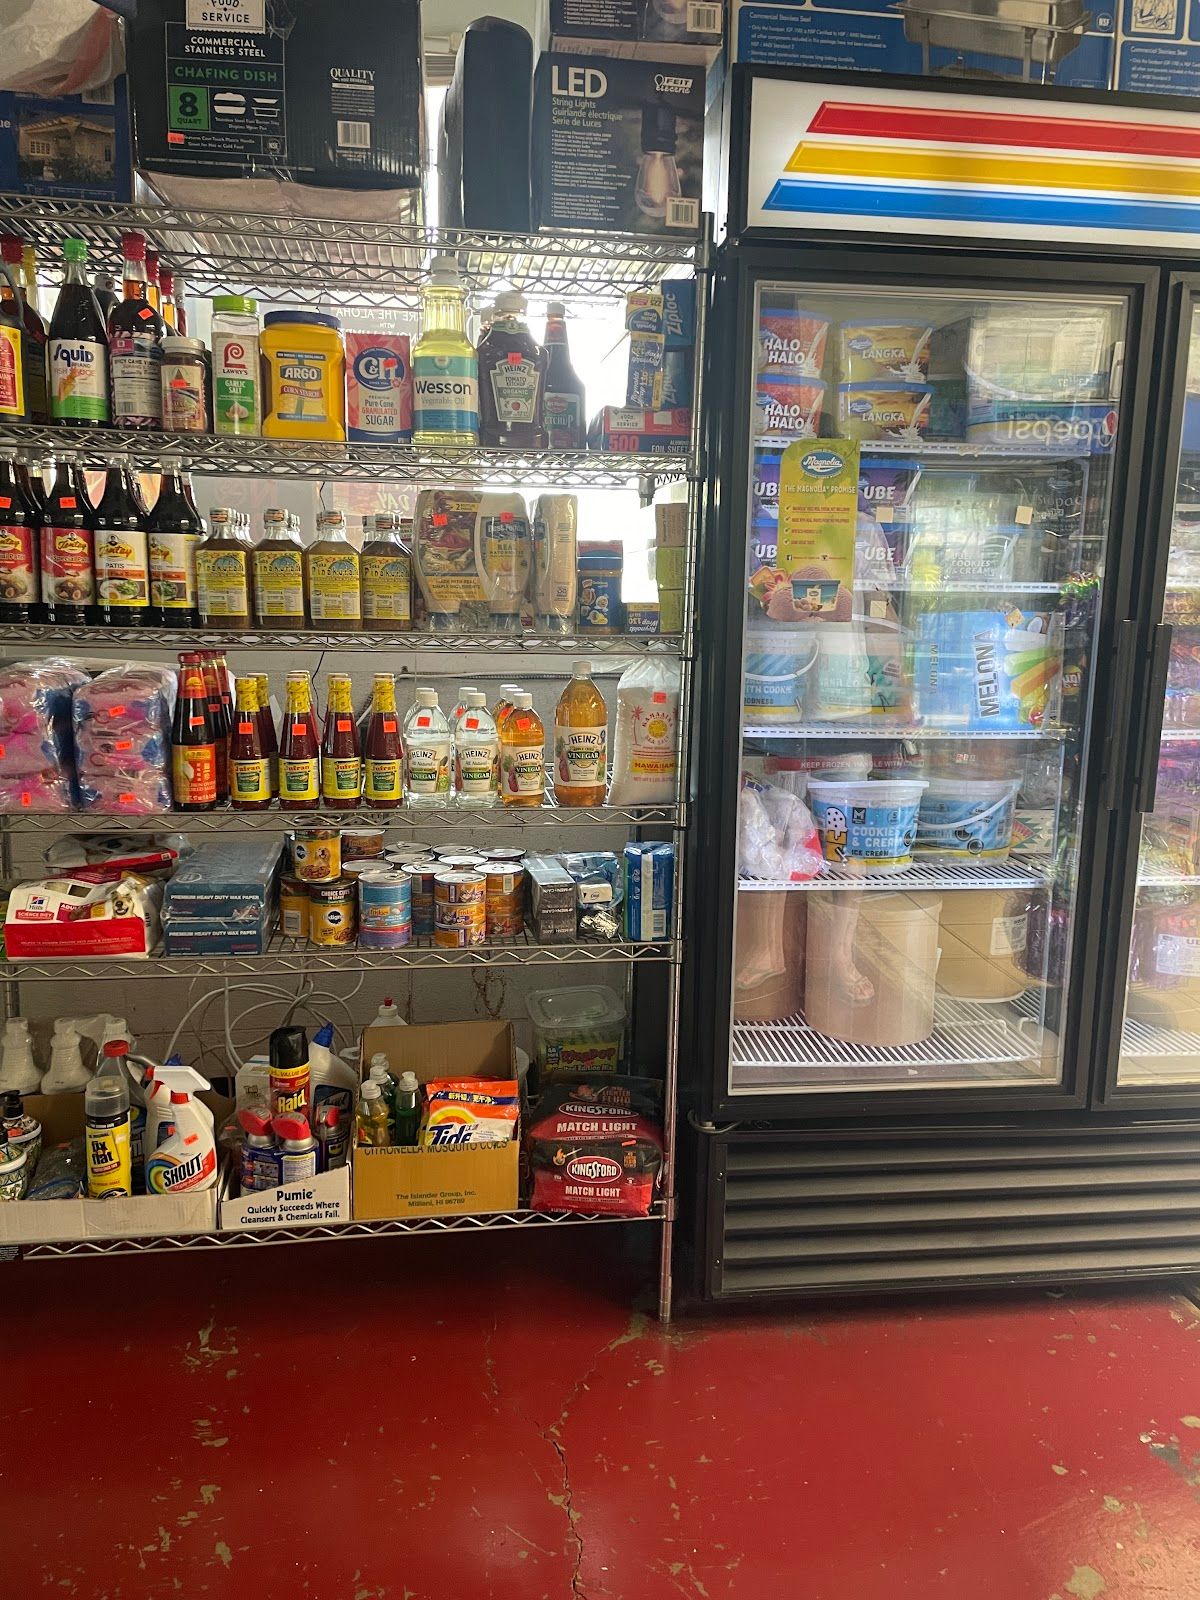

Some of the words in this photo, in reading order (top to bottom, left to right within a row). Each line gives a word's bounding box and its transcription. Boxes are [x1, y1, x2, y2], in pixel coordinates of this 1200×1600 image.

[202, 12, 250, 23] SERVICE
[190, 36, 257, 48] COMMERCIAL
[184, 45, 235, 55] STAINLESS
[238, 48, 266, 57] STEEL
[174, 66, 240, 80] CHAFING
[244, 70, 277, 82] DISH
[330, 67, 375, 81] QUALITY
[551, 65, 608, 98] LED
[666, 78, 690, 86] FEIT
[179, 92, 199, 117] 8
[552, 98, 573, 108] String
[575, 99, 596, 109] Lights
[552, 107, 586, 118] Guirlande
[177, 117, 201, 125] QUART
[552, 116, 570, 126] Serie
[571, 118, 580, 127] de
[582, 119, 602, 128] Luces
[668, 293, 682, 335] Ziploc
[764, 338, 800, 351] HALO
[768, 351, 805, 364] HALO
[862, 349, 906, 359] LANGKA
[284, 367, 318, 380] ARGO
[504, 364, 527, 374] HEINZ
[224, 380, 246, 388] GARLIC
[415, 381, 472, 395] Wesson
[364, 399, 378, 408] Pure
[361, 408, 398, 416] GRANULATED
[765, 404, 801, 417] HALO
[365, 415, 394, 426] SUGAR
[862, 412, 905, 422] LANGKA
[769, 417, 805, 430] HALO
[608, 434, 640, 453] 500
[651, 444, 666, 453] FOIL
[803, 456, 843, 469] Magnolia
[831, 486, 856, 494] PROMISE
[864, 486, 896, 500] UBE
[864, 547, 897, 561] UBE
[974, 628, 1000, 719] MELONA
[571, 734, 597, 745] HEINZ
[411, 750, 433, 758] HEINZ
[465, 750, 487, 758] HEINZ
[518, 752, 539, 760] HEINZ
[568, 751, 599, 759] VINEGAR
[800, 761, 820, 769] KEEP
[822, 761, 850, 769] FROZEN
[410, 772, 436, 780] VINEGAR
[851, 837, 859, 847] &
[277, 1088, 308, 1113] Raid
[565, 1104, 632, 1115] KINGSFORD
[556, 1122, 599, 1132] MATCH
[602, 1122, 638, 1132] LIGHT
[428, 1124, 473, 1146] Tide
[91, 1140, 108, 1151] fix
[364, 1145, 424, 1156] CITRONELLA
[427, 1142, 477, 1153] MOSQUITO
[91, 1152, 114, 1165] flat
[163, 1152, 202, 1187] SHOUT
[571, 1161, 617, 1179] KINGSFORD
[276, 1189, 313, 1201] Pumie
[440, 1191, 463, 1199] Group,
[565, 1185, 594, 1196] MATCH
[596, 1187, 622, 1197] LIGHT
[247, 1205, 278, 1214] Quickly
[279, 1203, 314, 1212] Succeeds
[315, 1201, 340, 1209] Where
[240, 1216, 276, 1224] Cleansers
[286, 1212, 323, 1221] Chemicals
[325, 1210, 340, 1218] Fail.
